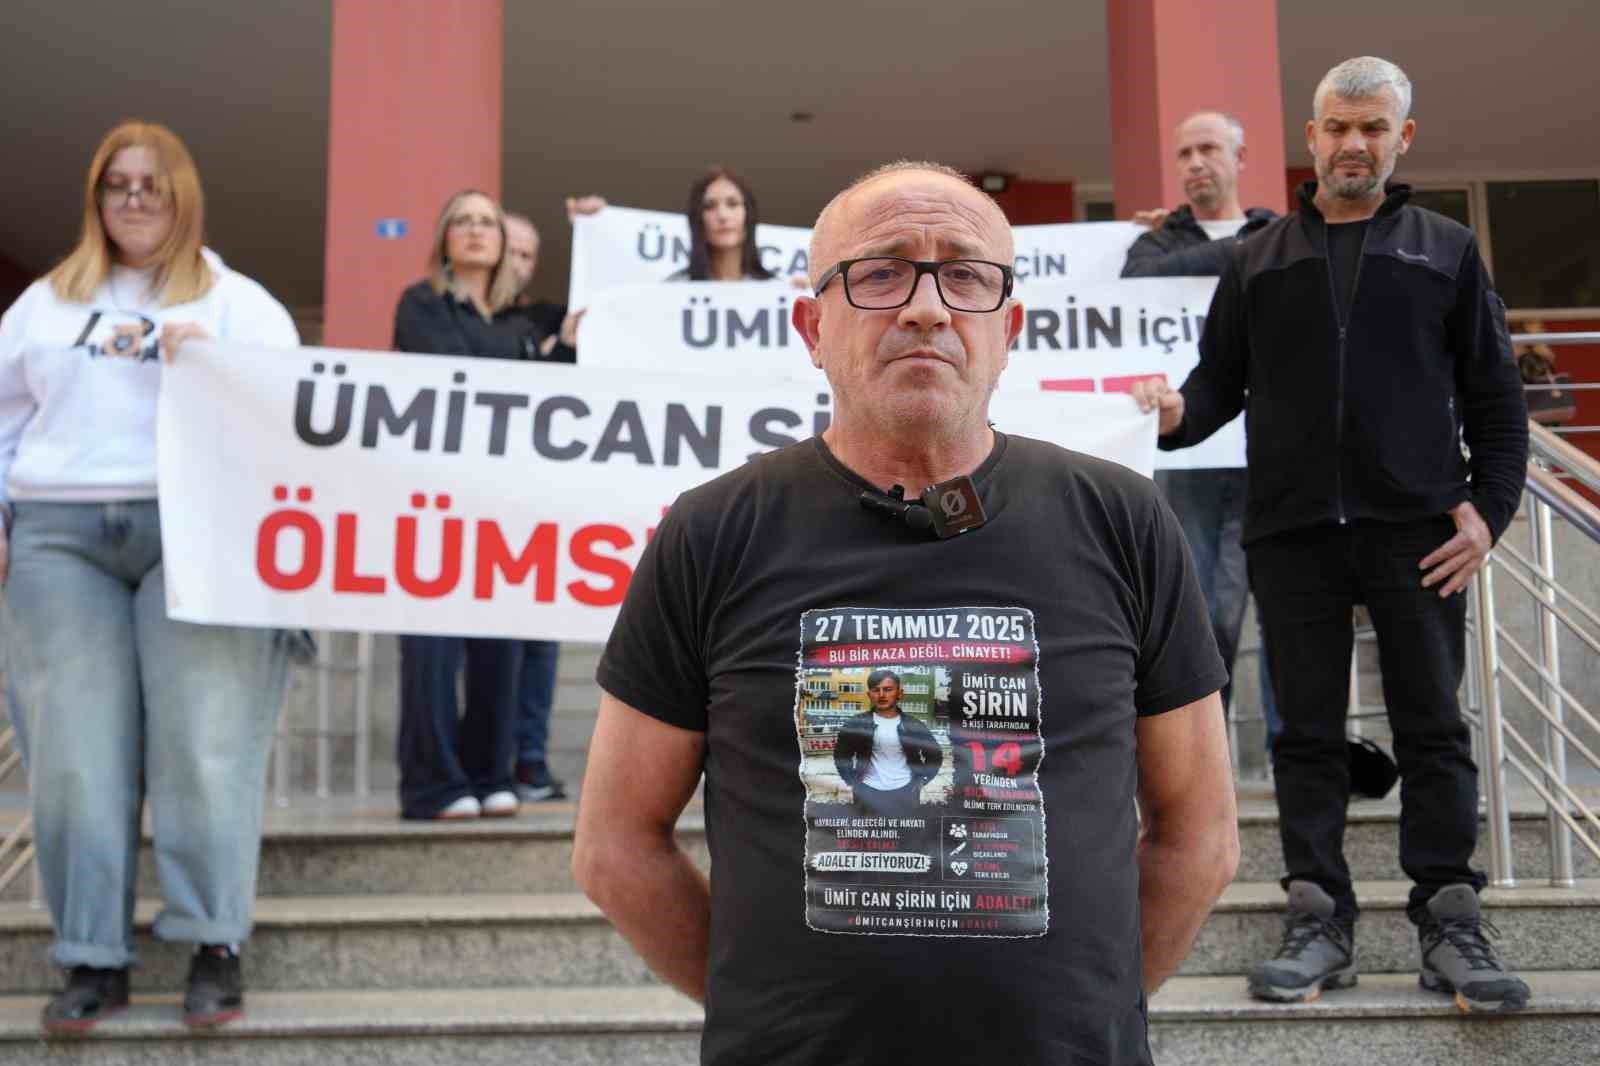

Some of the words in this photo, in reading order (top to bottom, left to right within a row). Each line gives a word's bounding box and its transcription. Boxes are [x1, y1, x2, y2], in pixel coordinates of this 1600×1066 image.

[1013, 248, 1066, 282] ÇİN
[1012, 296, 1123, 350] RİN
[294, 363, 721, 467] ÜMİTCAN
[255, 485, 660, 607] ÖLÜMS
[815, 616, 843, 642] 27
[852, 614, 960, 641] TEMMUZ
[967, 614, 1025, 641] 2025
[829, 650, 846, 663] BU
[849, 647, 869, 662] BİR
[873, 647, 905, 661] KAZA
[952, 643, 1012, 659] CİNAYET!
[962, 672, 996, 689] ÜMİT
[999, 676, 1027, 690] CAN
[962, 690, 1027, 719] ŞİRİN
[962, 719, 968, 728] 5
[985, 720, 1030, 730] TARAFINDAN
[963, 741, 1023, 775] 14
[973, 773, 1018, 789] YERİNDEN
[888, 818, 898, 828] VE
[818, 855, 858, 868] ADALET
[860, 853, 925, 870] İSTİYORUZ!
[824, 888, 857, 906] ÜMİT
[861, 891, 890, 907] CAN
[895, 889, 936, 911] ŞİRİN
[941, 891, 971, 911] İÇİN
